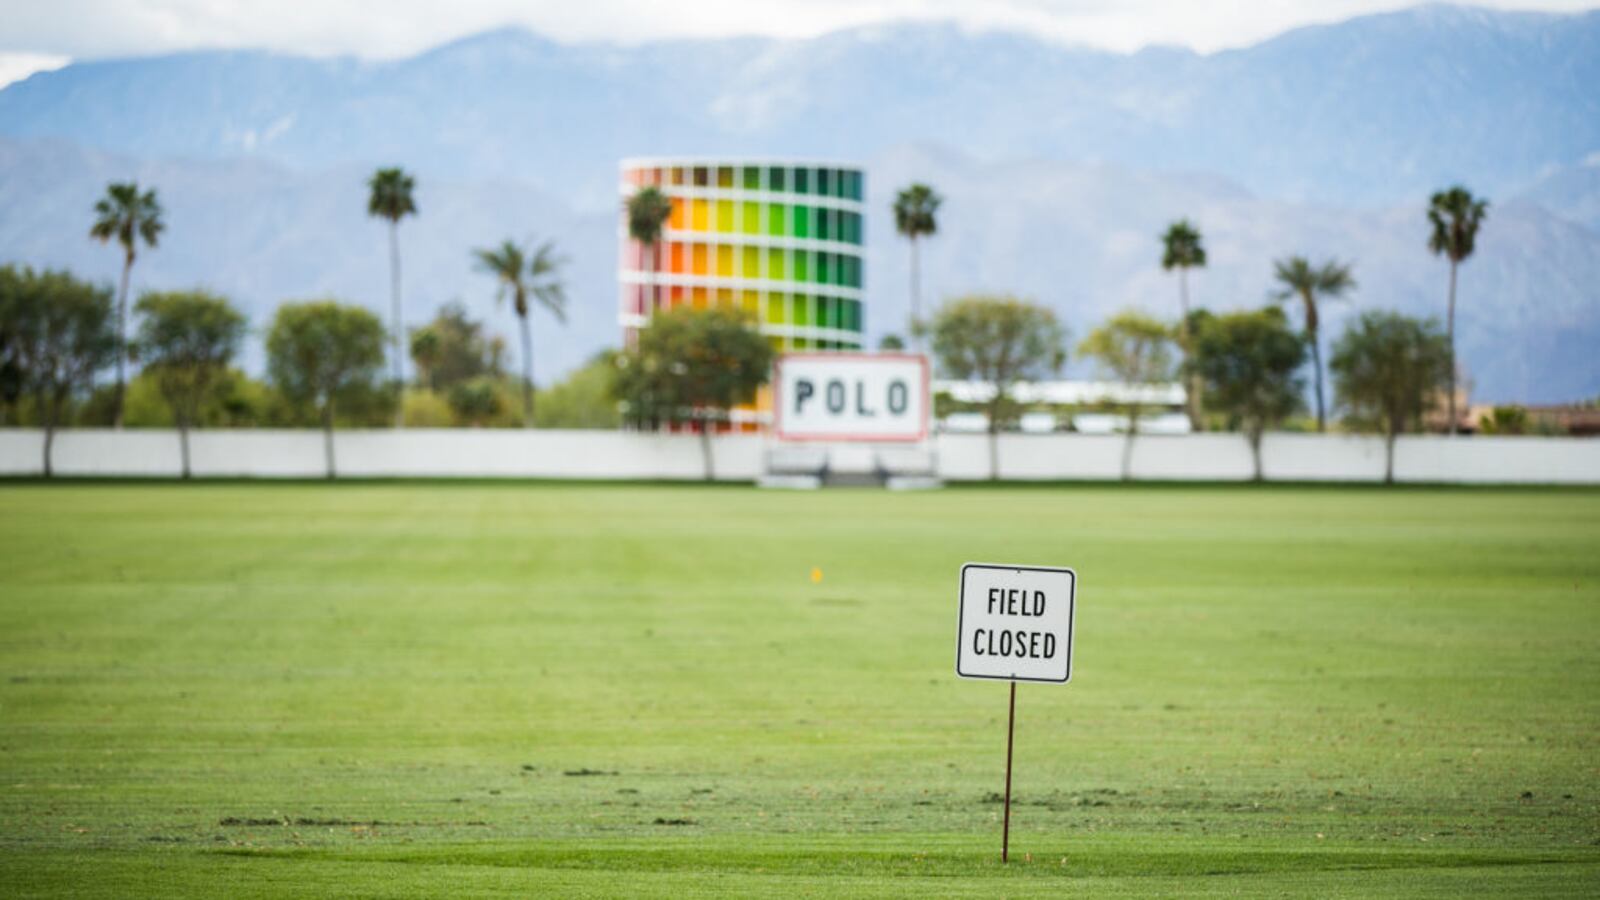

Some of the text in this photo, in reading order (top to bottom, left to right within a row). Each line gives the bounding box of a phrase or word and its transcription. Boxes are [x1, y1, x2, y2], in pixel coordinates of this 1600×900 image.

[794, 379, 908, 415] POLO
[987, 588, 1046, 617] FIELD
[973, 628, 1056, 659] CLOSED
